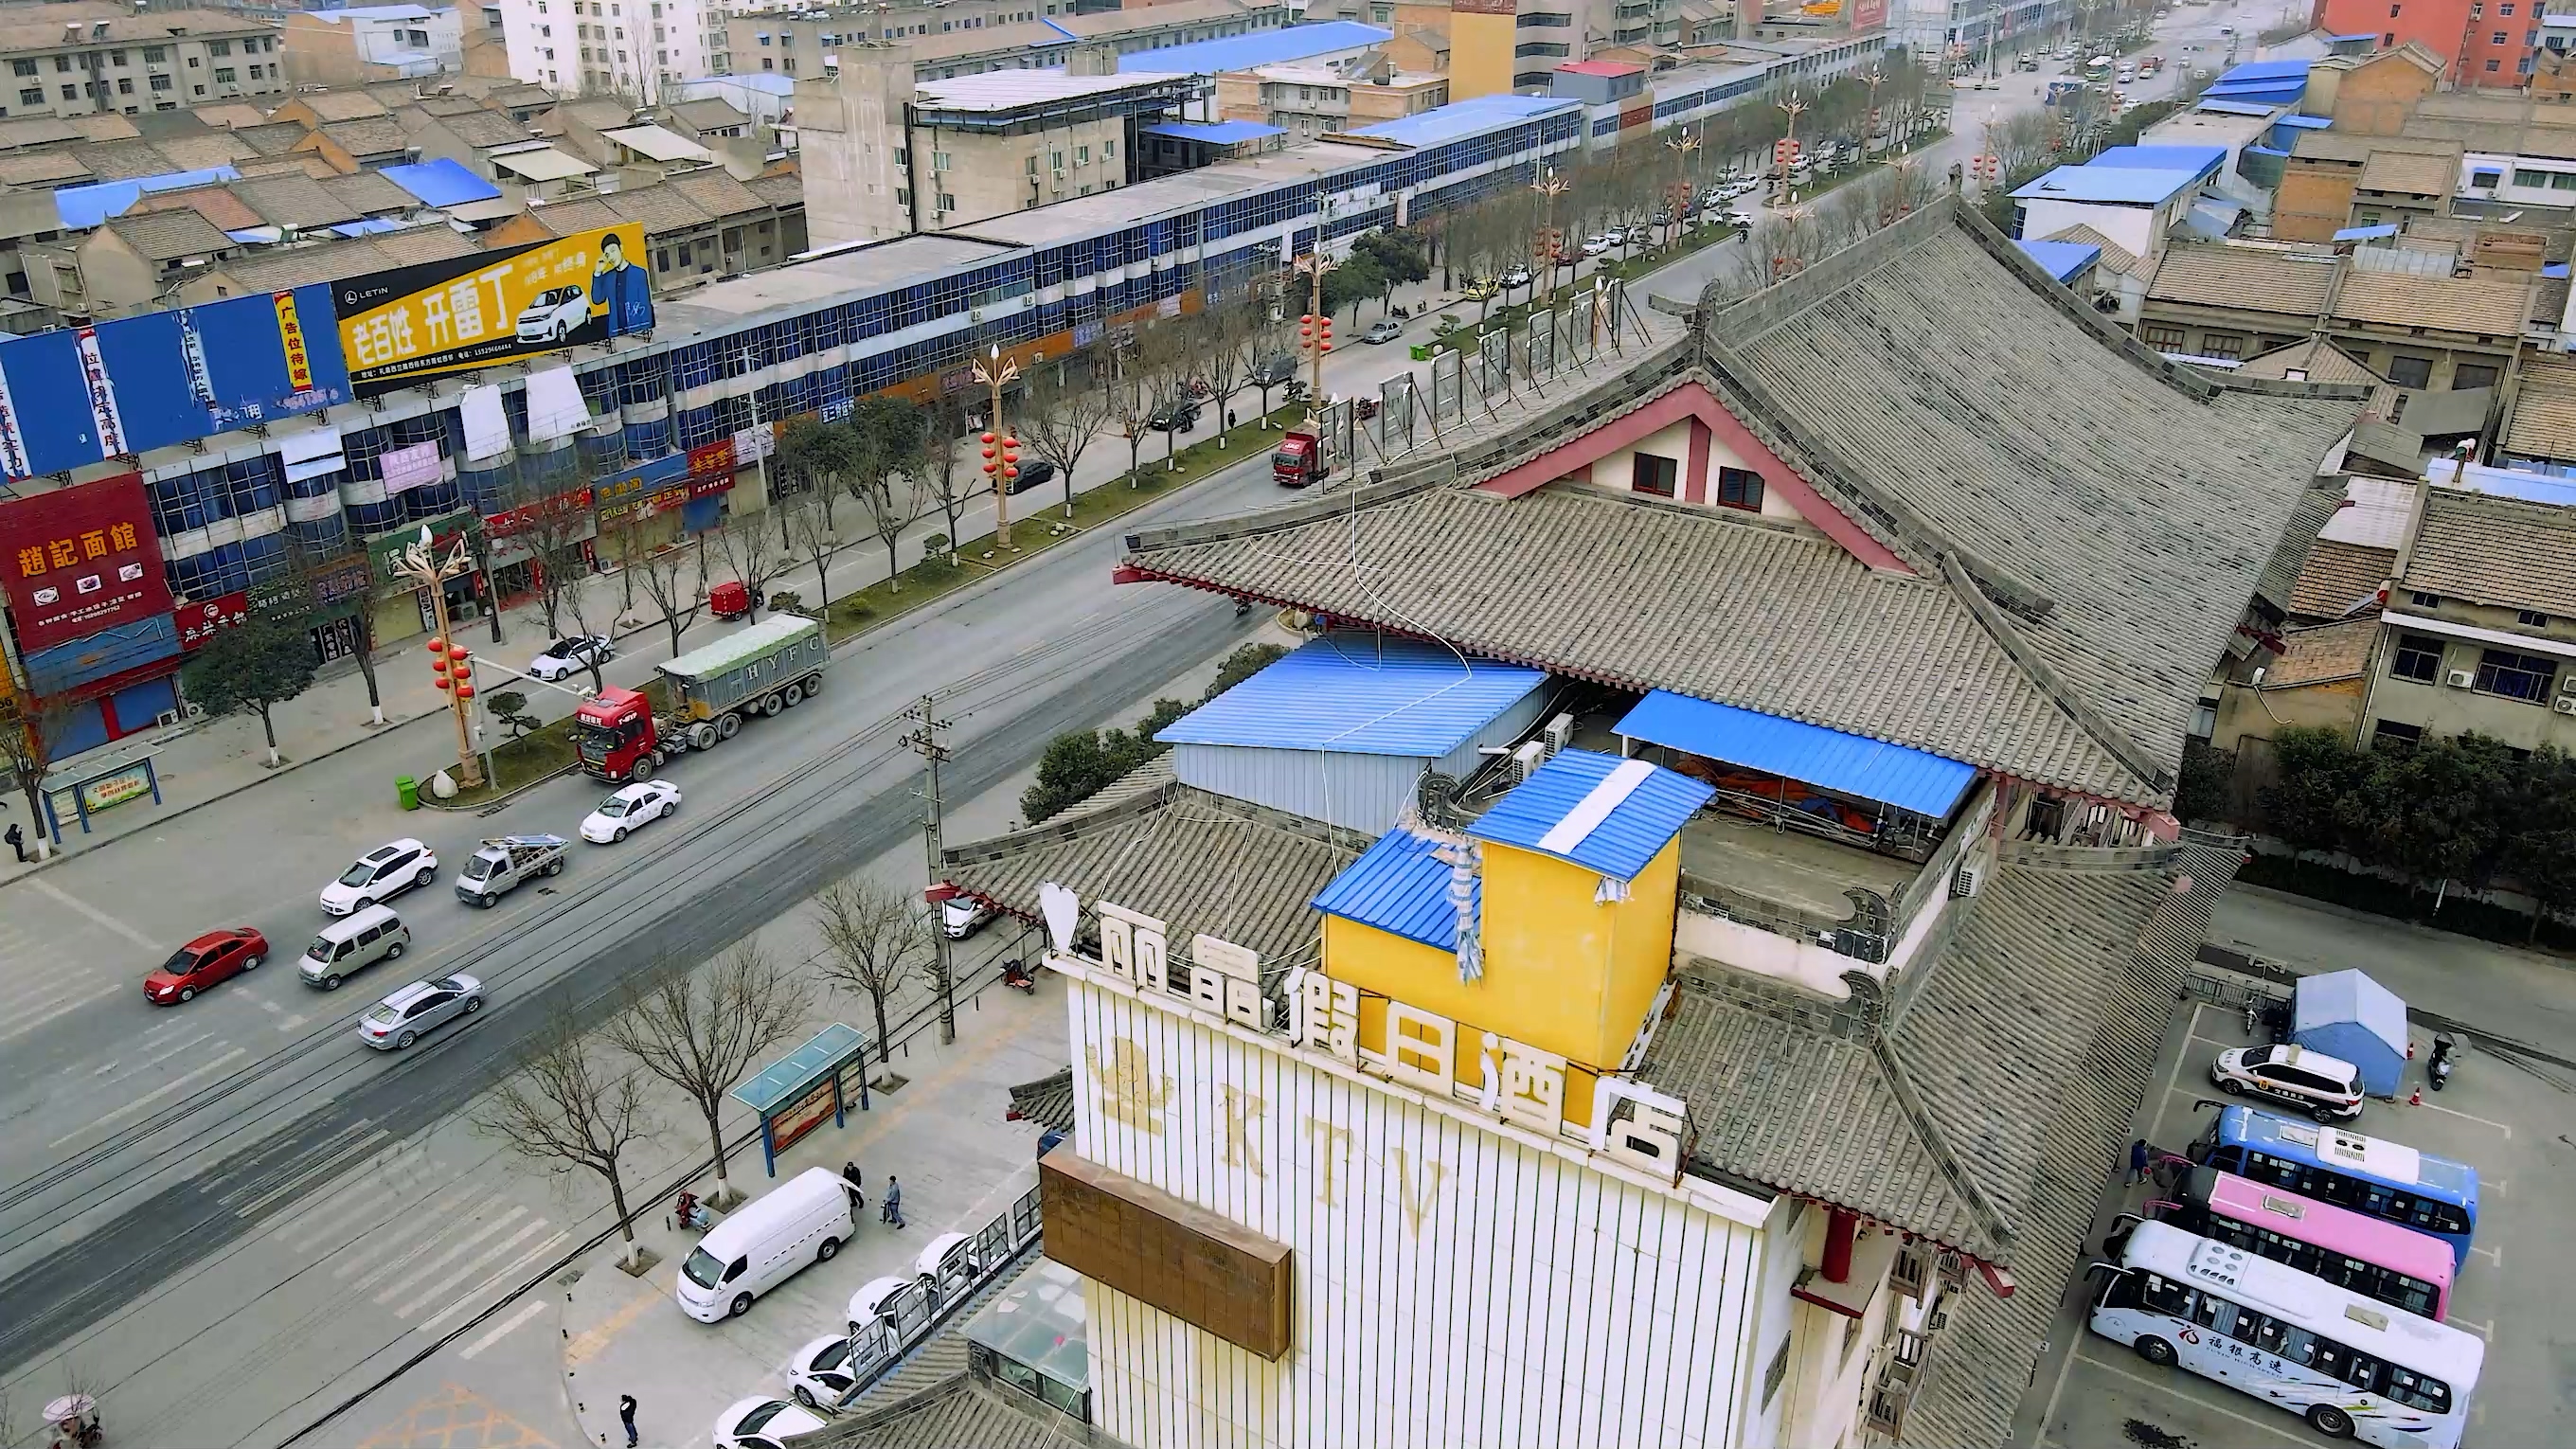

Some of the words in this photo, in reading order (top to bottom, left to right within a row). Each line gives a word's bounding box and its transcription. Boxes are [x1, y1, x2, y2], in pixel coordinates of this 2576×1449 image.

[352, 305, 417, 366] 老百姓
[422, 264, 513, 348] 开雷丁
[359, 287, 389, 299] LETIN
[280, 306, 309, 383] 广告位待嫁
[18, 522, 138, 578] 趙記面館
[1098, 900, 1687, 1178] 丽晶假日酒店
[2209, 1336, 2283, 1374] 福银高速
